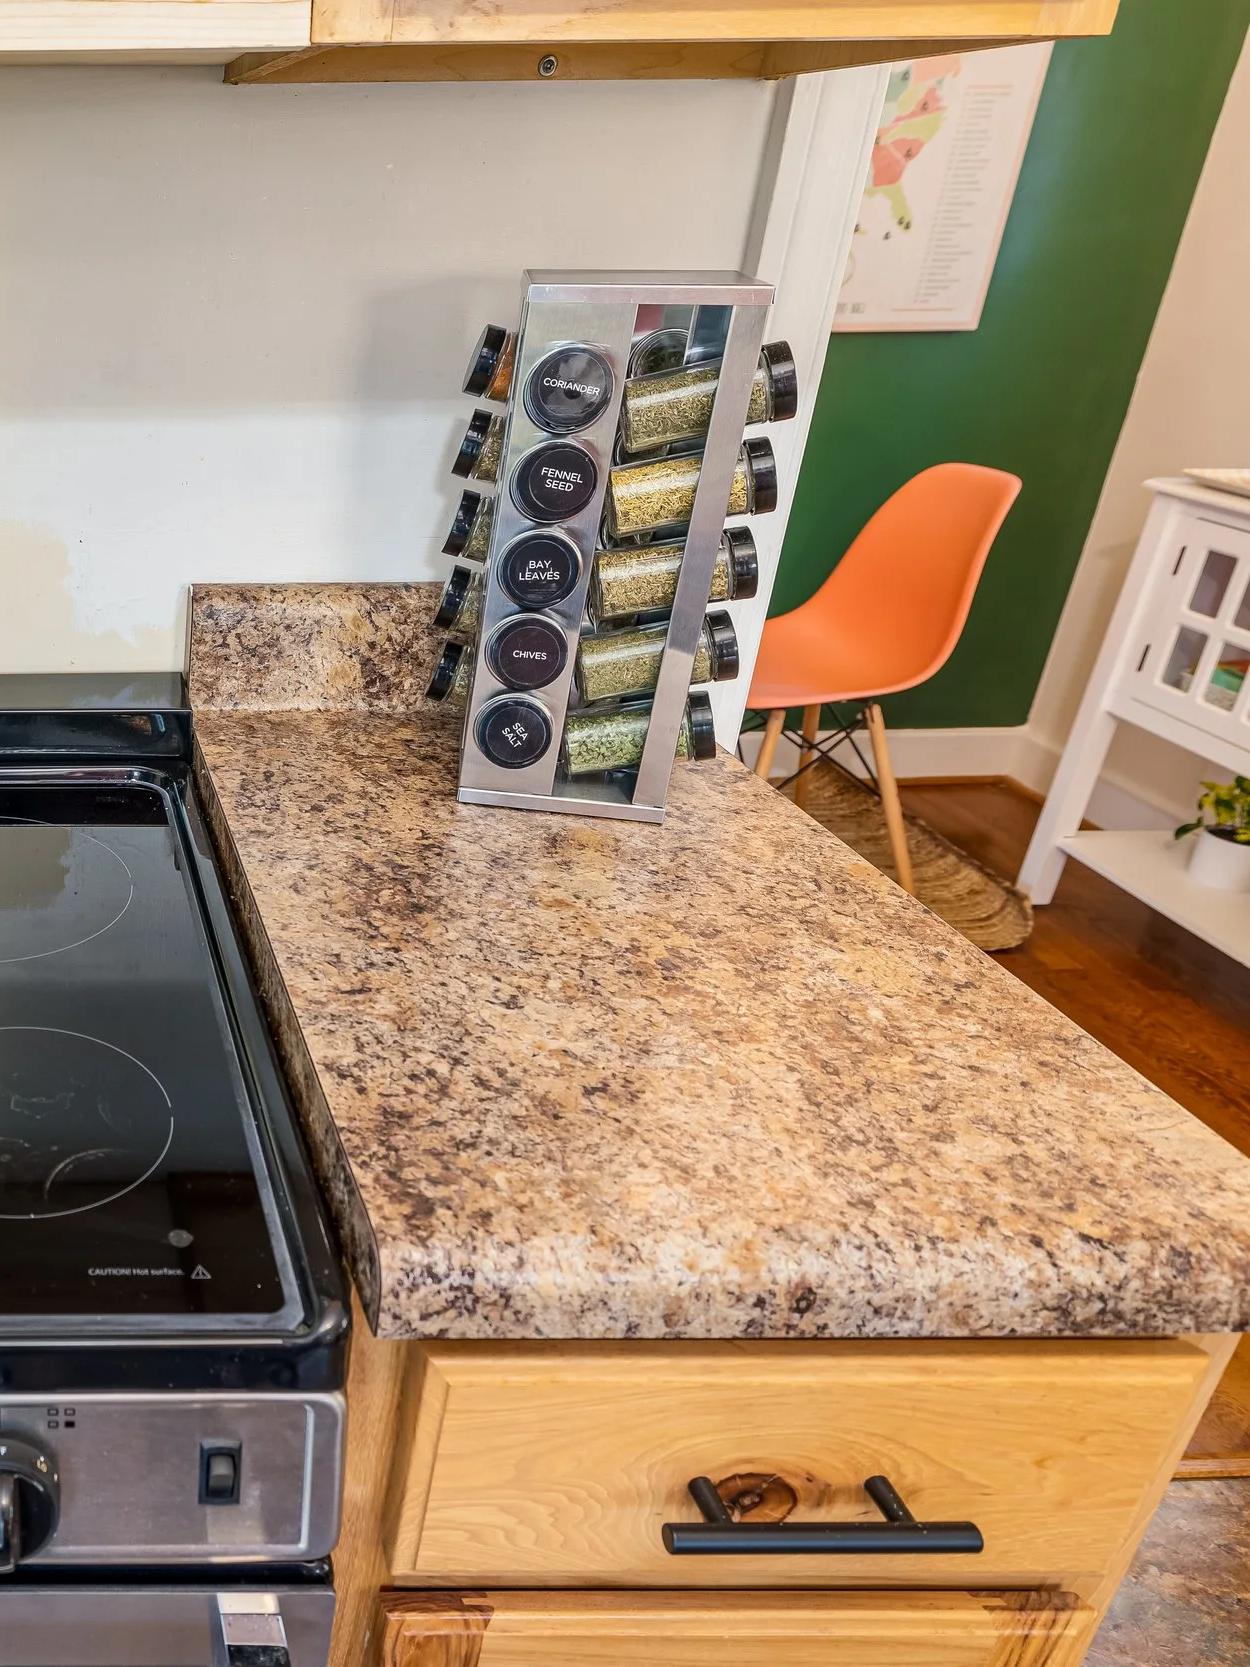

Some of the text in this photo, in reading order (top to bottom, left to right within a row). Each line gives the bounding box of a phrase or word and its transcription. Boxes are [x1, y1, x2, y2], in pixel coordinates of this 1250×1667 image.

[543, 377, 600, 396] CORIANDER
[541, 467, 583, 483] FENNEL
[545, 479, 574, 492] SEED
[529, 560, 551, 569] BAY
[519, 571, 560, 581] LEAVES
[513, 650, 547, 660] CHIVES
[502, 727, 522, 748] SALT
[512, 722, 529, 741] SEA
[88, 1268, 131, 1276] CAUTION!
[132, 1267, 149, 1276] Hot
